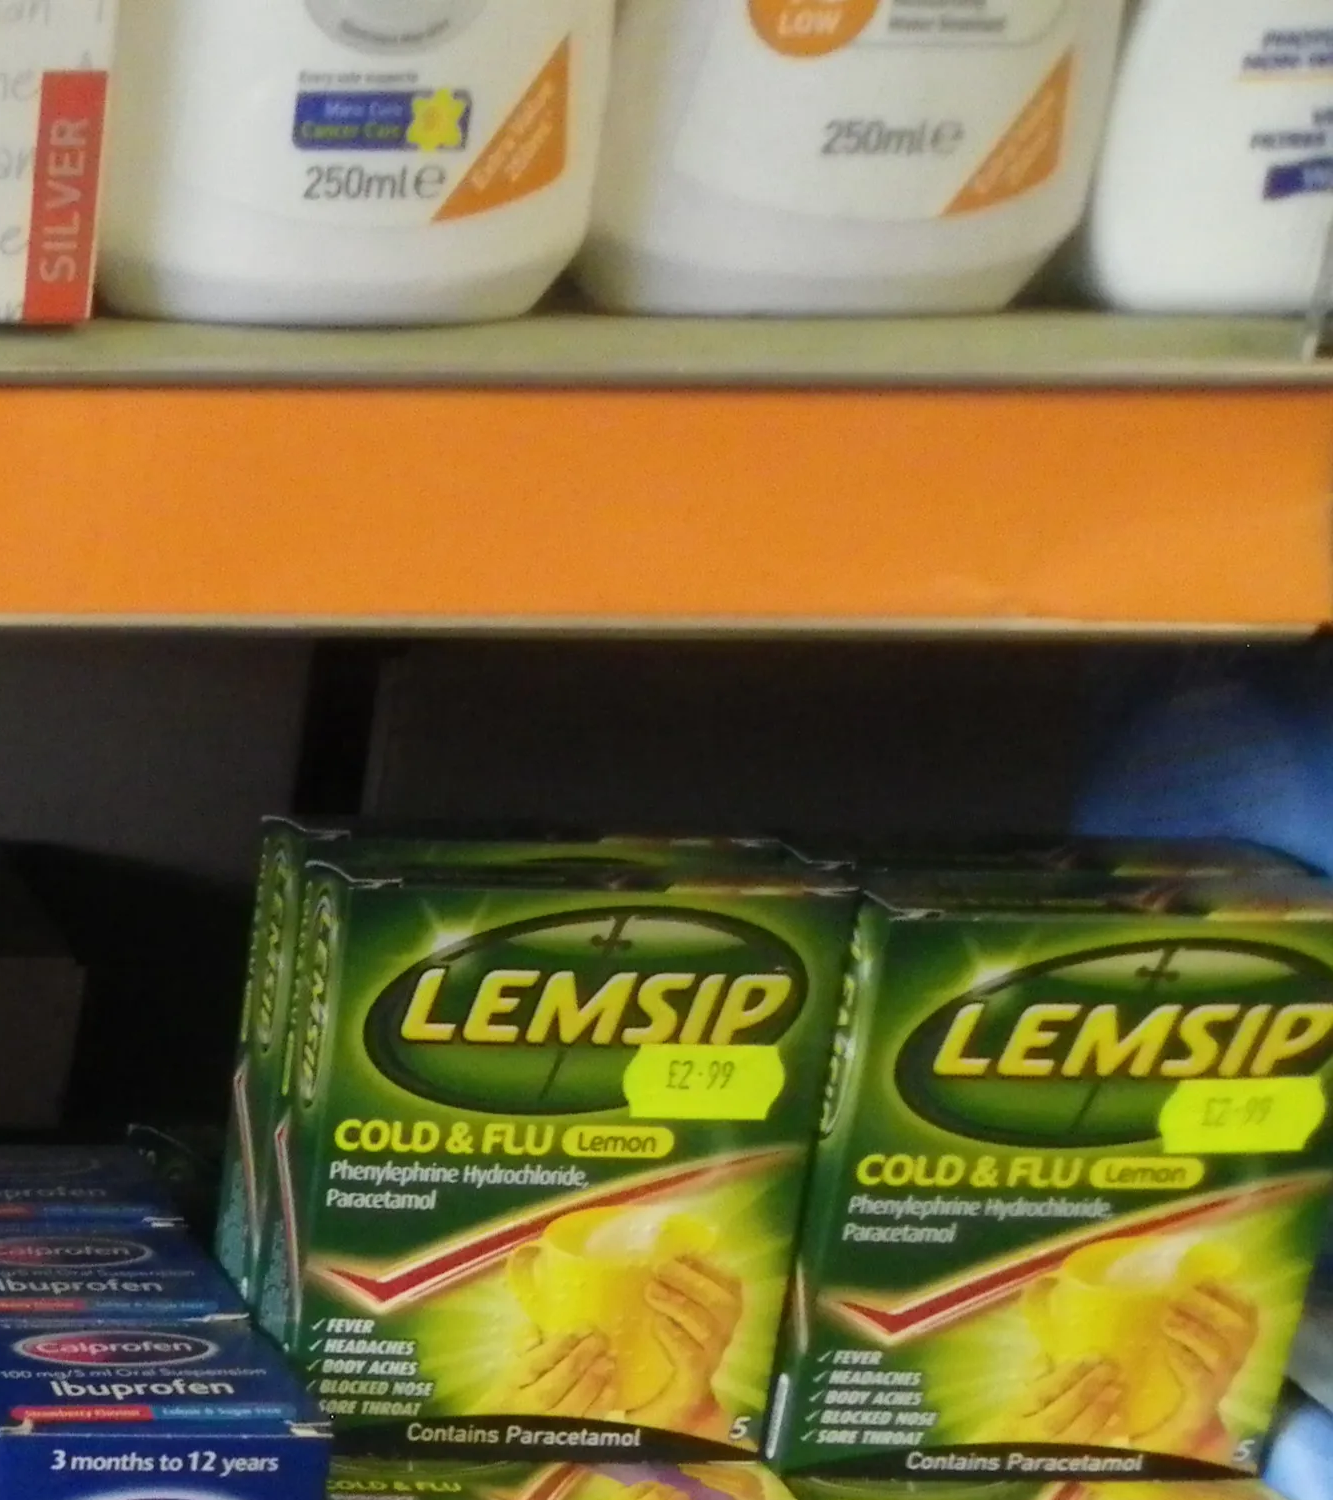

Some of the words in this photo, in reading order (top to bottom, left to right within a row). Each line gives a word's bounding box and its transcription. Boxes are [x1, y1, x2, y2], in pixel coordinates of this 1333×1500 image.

[820, 118, 927, 156] 250ml
[303, 165, 407, 201] 250ml
[38, 117, 88, 283] SILVER
[399, 967, 793, 1046] LEMSIP
[932, 1002, 1333, 1078] LEMSIP
[334, 1119, 440, 1153] COLD
[445, 1120, 475, 1154] &
[482, 1123, 556, 1157] FLU
[577, 1133, 658, 1154] Lemon
[329, 1161, 459, 1187] Phenylephrine
[463, 1162, 589, 1190] Hydrochloride,
[857, 1153, 965, 1188] COLD
[969, 1156, 999, 1188] &
[1008, 1158, 1083, 1189] FLU
[1103, 1162, 1186, 1186] Lemon
[326, 1188, 436, 1212] Paracetamol
[848, 1195, 979, 1220] Phenylephrine
[842, 1222, 957, 1245] Paracetamol
[326, 1318, 375, 1335] FEVER
[36, 1338, 193, 1357] Calprofen
[323, 1338, 416, 1356] HEADACHES
[320, 1358, 364, 1376] BODY
[367, 1359, 418, 1376] ACHES
[50, 1379, 235, 1398] Ibuprofen
[406, 1422, 499, 1444] Contains
[504, 1426, 642, 1448] Paracetamol
[50, 1449, 67, 1471] 3
[70, 1452, 155, 1472] months
[159, 1454, 184, 1472] to
[187, 1451, 216, 1472] 12
[219, 1456, 280, 1476] years
[906, 1450, 1002, 1472] Contains
[1006, 1452, 1144, 1474] Paracetamol
